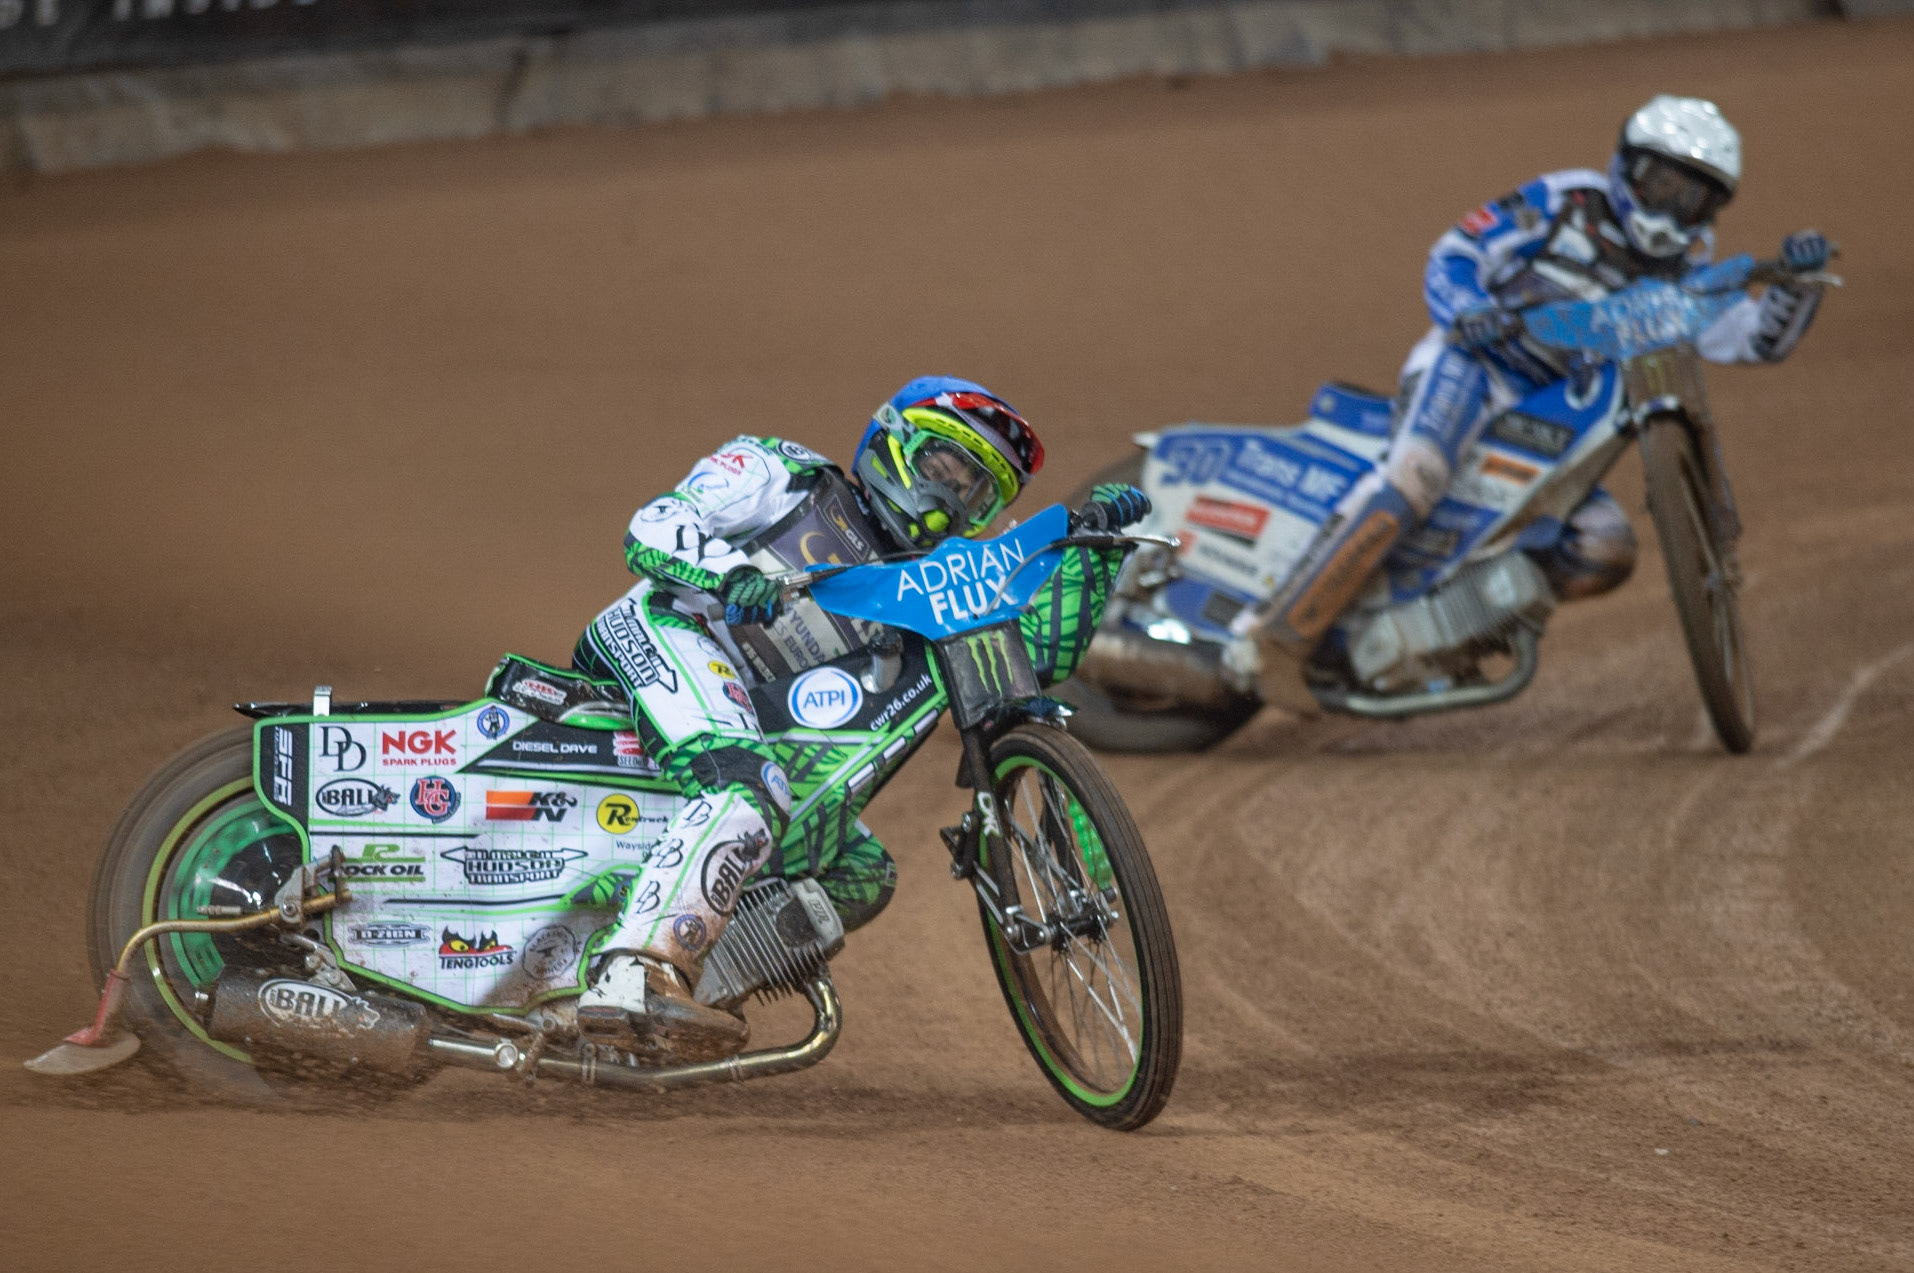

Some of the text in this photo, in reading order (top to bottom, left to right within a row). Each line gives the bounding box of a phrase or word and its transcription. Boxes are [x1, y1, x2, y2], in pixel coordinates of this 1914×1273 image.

[896, 537, 1025, 602] ADRIAN
[928, 574, 1018, 626] FLUX
[802, 690, 846, 709] ATPI
[870, 673, 932, 731] cwr26.co.uk
[382, 729, 457, 755] NGK
[512, 740, 598, 755] DIESEL DAVE
[382, 758, 457, 766] SPARK PLUGS
[529, 791, 578, 822] K&N
[341, 864, 424, 876] OCK OIL
